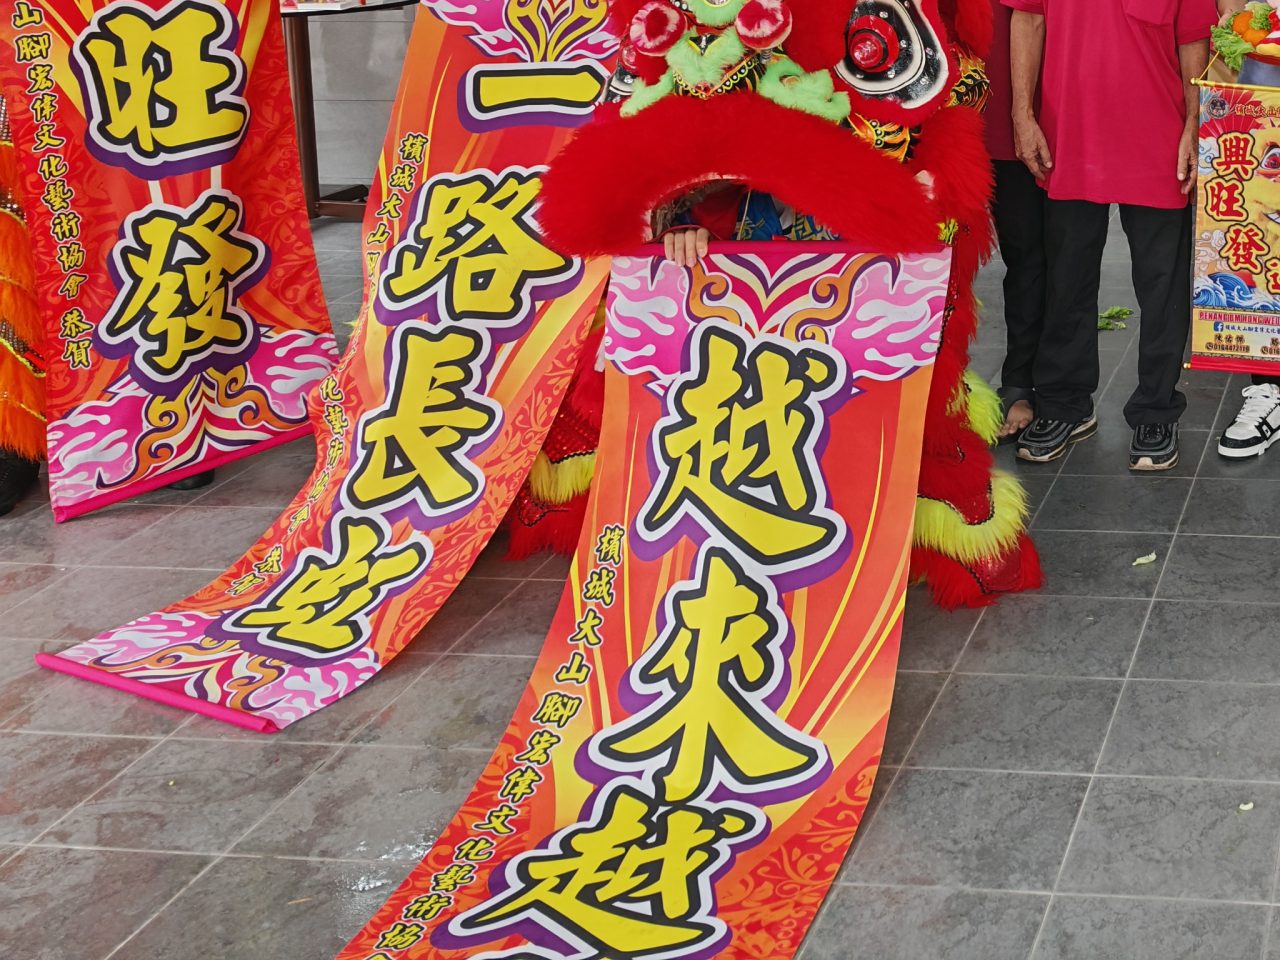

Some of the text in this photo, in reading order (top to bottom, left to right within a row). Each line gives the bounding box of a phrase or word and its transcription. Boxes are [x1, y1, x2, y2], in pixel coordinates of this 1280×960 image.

[60, 308, 93, 368] 恭賀
[236, 68, 606, 651] 一路長紅
[1199, 311, 1228, 322] PENANG
[365, 524, 626, 960] 檳城大山腳宏偉文化藝術協
[462, 325, 838, 954] 越來越
